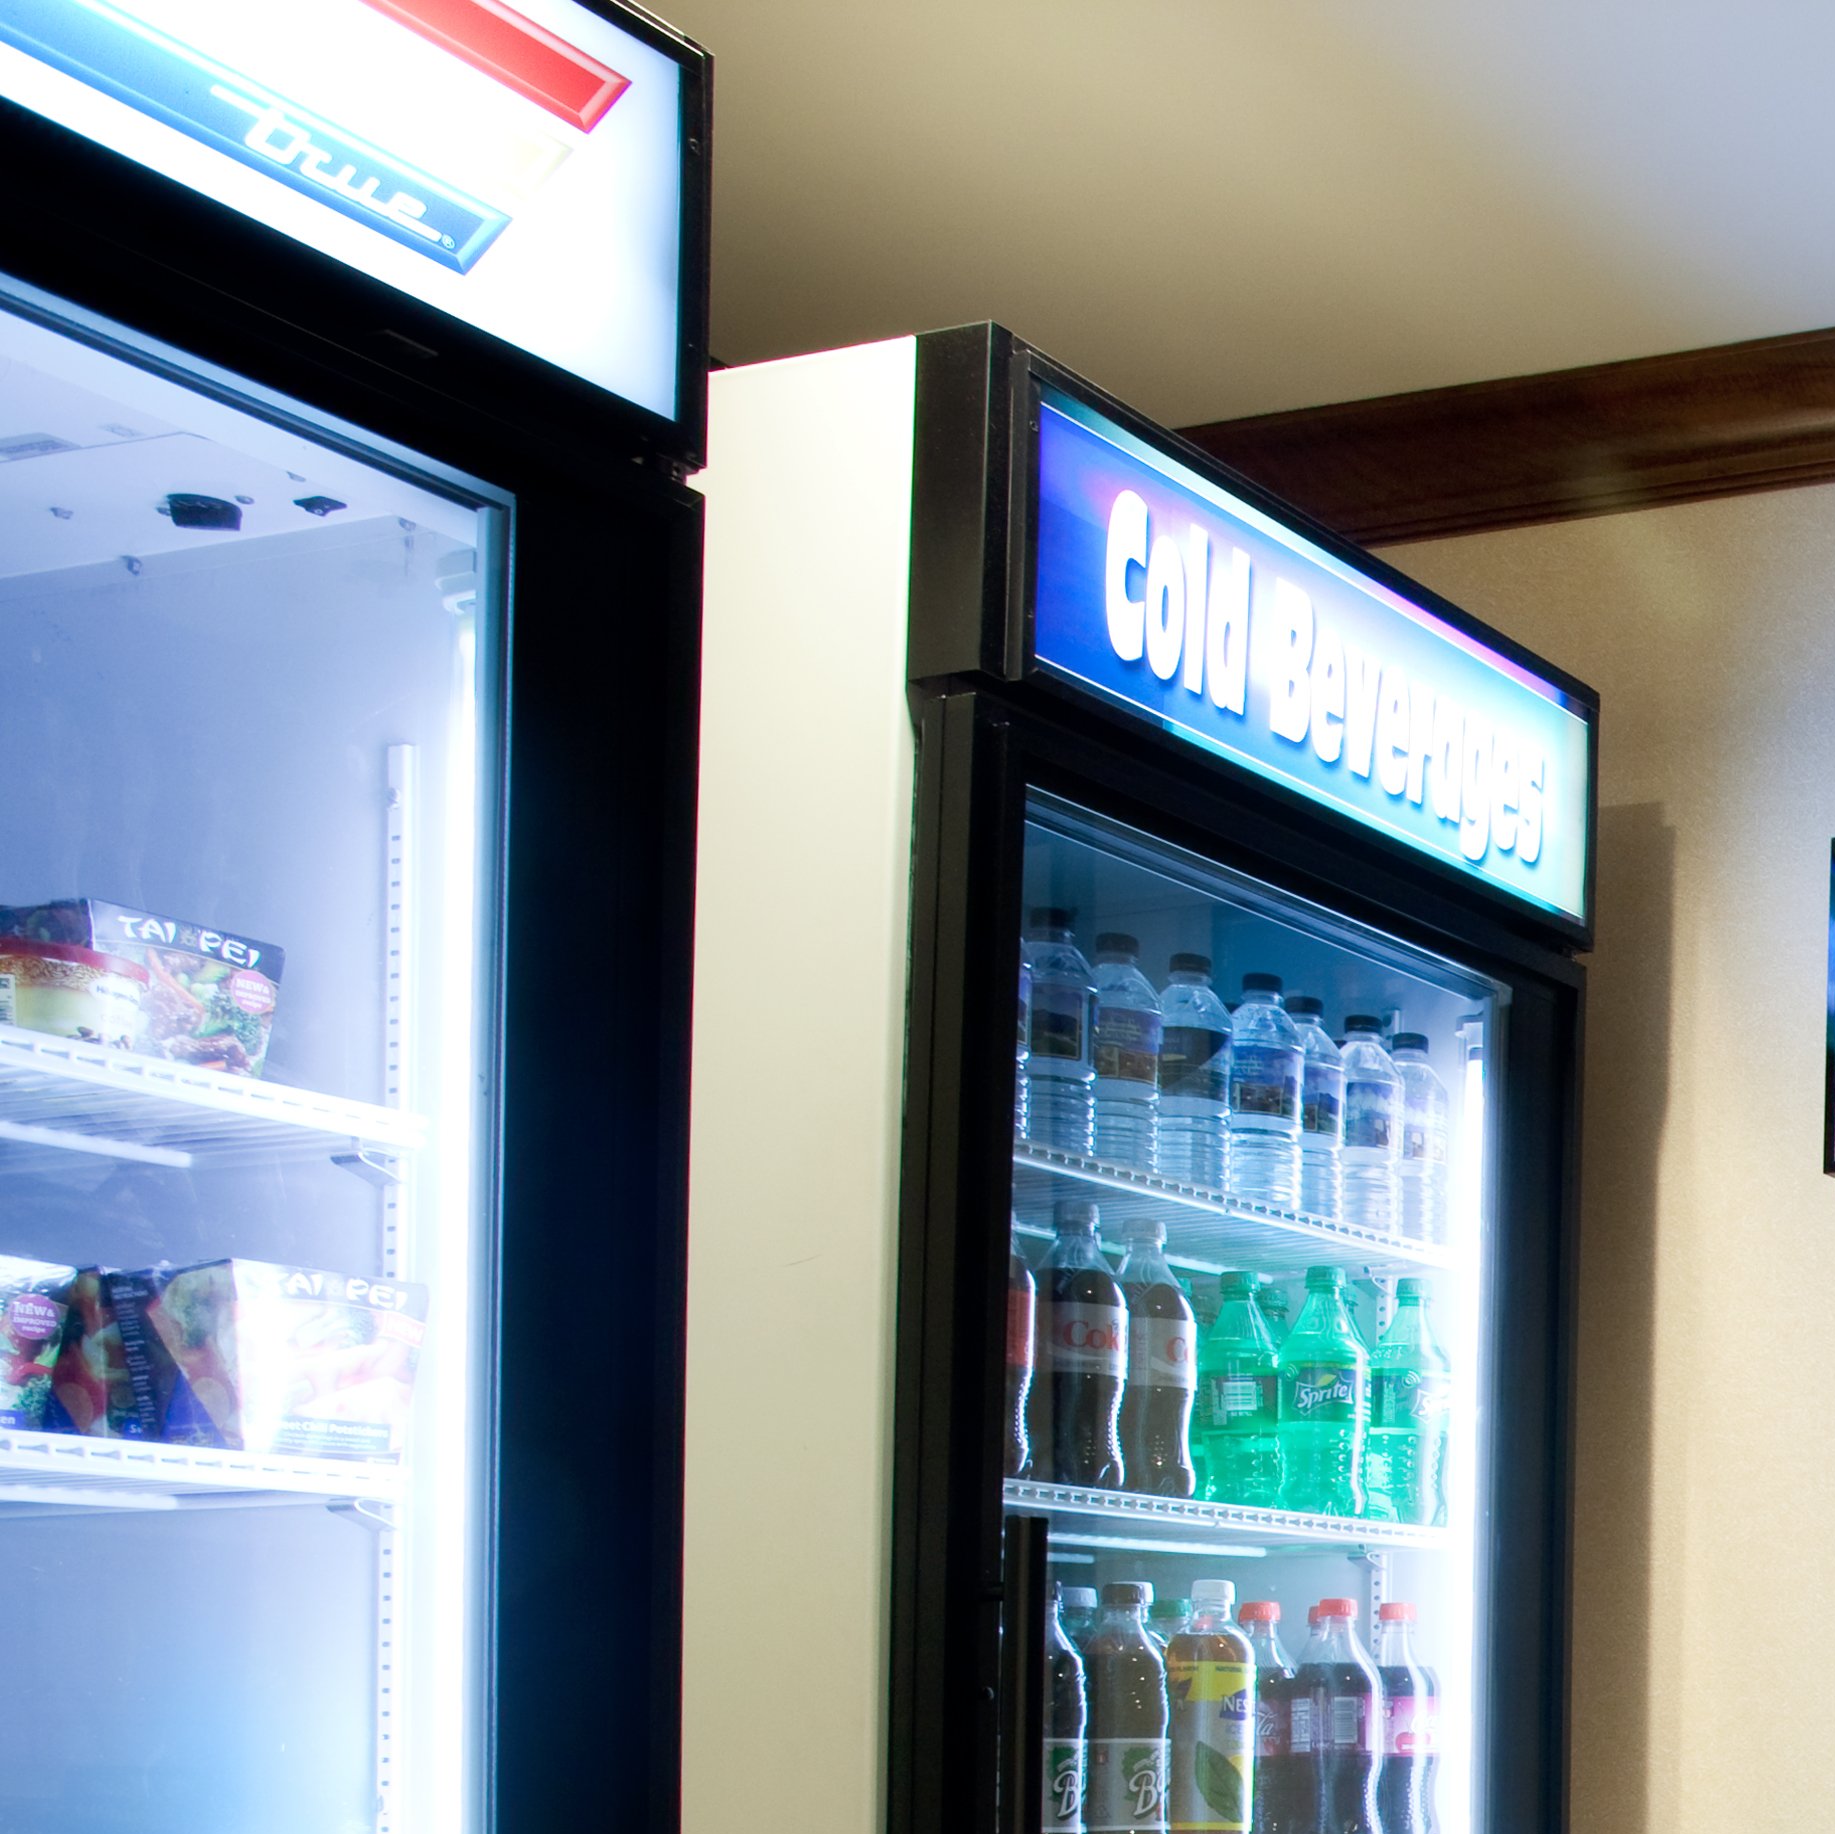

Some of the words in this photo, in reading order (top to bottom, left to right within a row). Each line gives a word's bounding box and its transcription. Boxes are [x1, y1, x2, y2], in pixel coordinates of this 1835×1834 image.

[1104, 489, 1252, 716] Cold
[1268, 576, 1548, 864] Beverages
[117, 914, 176, 944] TAI
[199, 930, 261, 968] PEI
[345, 1277, 409, 1312] PEI
[1063, 1319, 1120, 1351] Cok
[1297, 1381, 1348, 1409] Sprite
